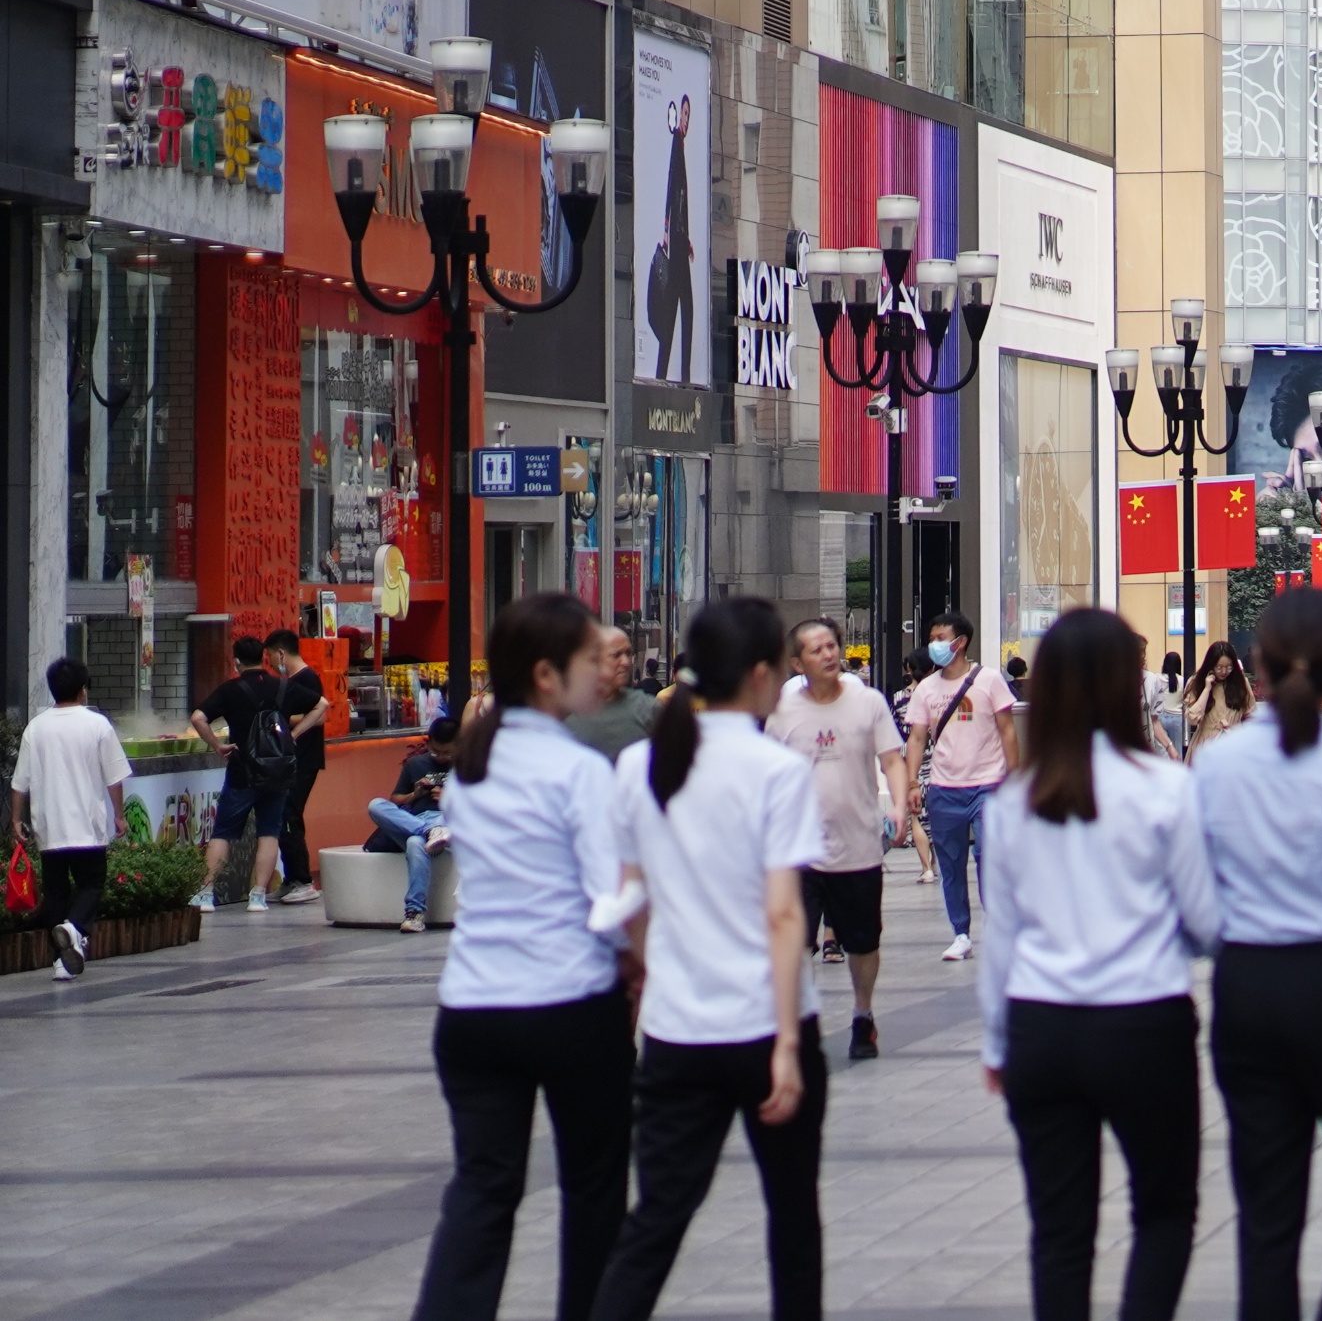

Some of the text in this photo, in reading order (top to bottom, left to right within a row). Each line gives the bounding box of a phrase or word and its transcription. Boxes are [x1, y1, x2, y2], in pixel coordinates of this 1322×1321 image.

[1038, 212, 1063, 265] IWC
[737, 258, 797, 325] MONT
[1030, 272, 1072, 297] SCHAFFHAUSEN
[737, 327, 798, 390] BLANC
[648, 407, 696, 434] MONTBLANC
